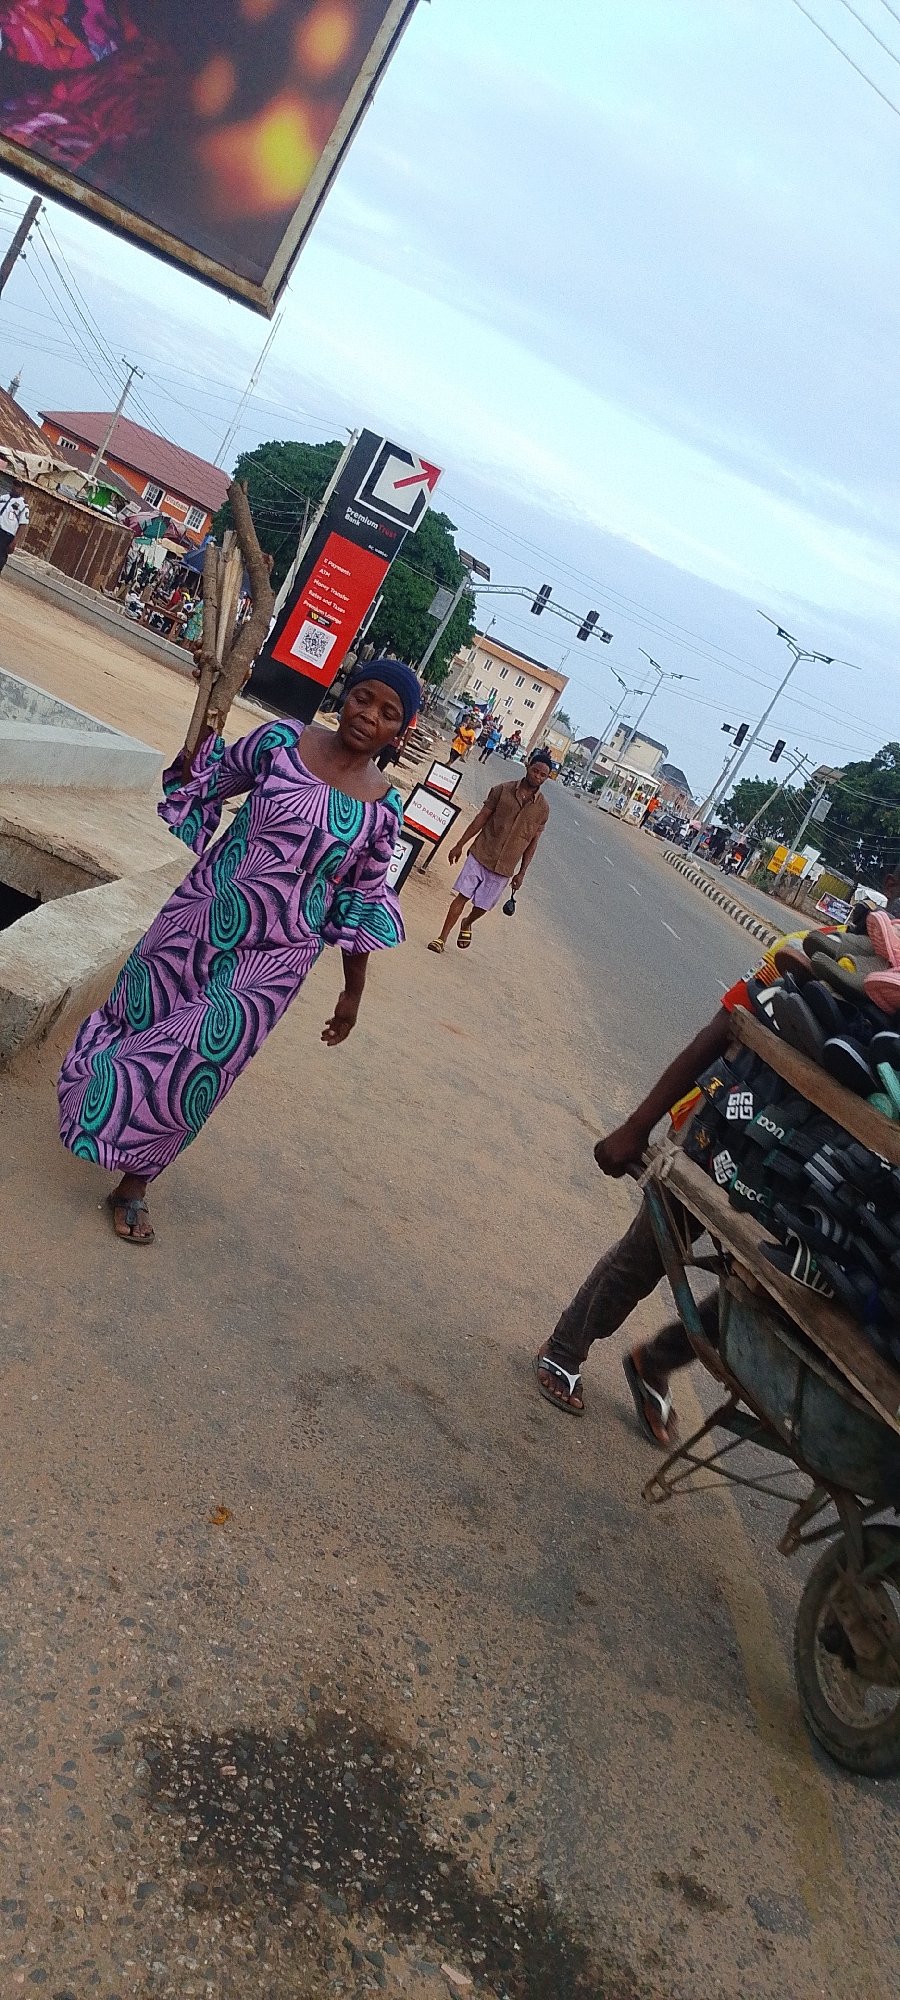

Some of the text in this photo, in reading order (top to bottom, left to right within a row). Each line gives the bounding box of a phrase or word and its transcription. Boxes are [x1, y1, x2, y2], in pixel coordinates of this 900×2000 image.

[344, 513, 361, 527] Bank
[318, 568, 331, 578] ATM
[328, 560, 351, 577] Payments
[308, 589, 346, 614] Rates and Taxes
[313, 579, 350, 602] Money Transfer
[302, 599, 325, 616] Premium
[324, 612, 343, 625] Lounge
[411, 800, 447, 826] NO PARKING
